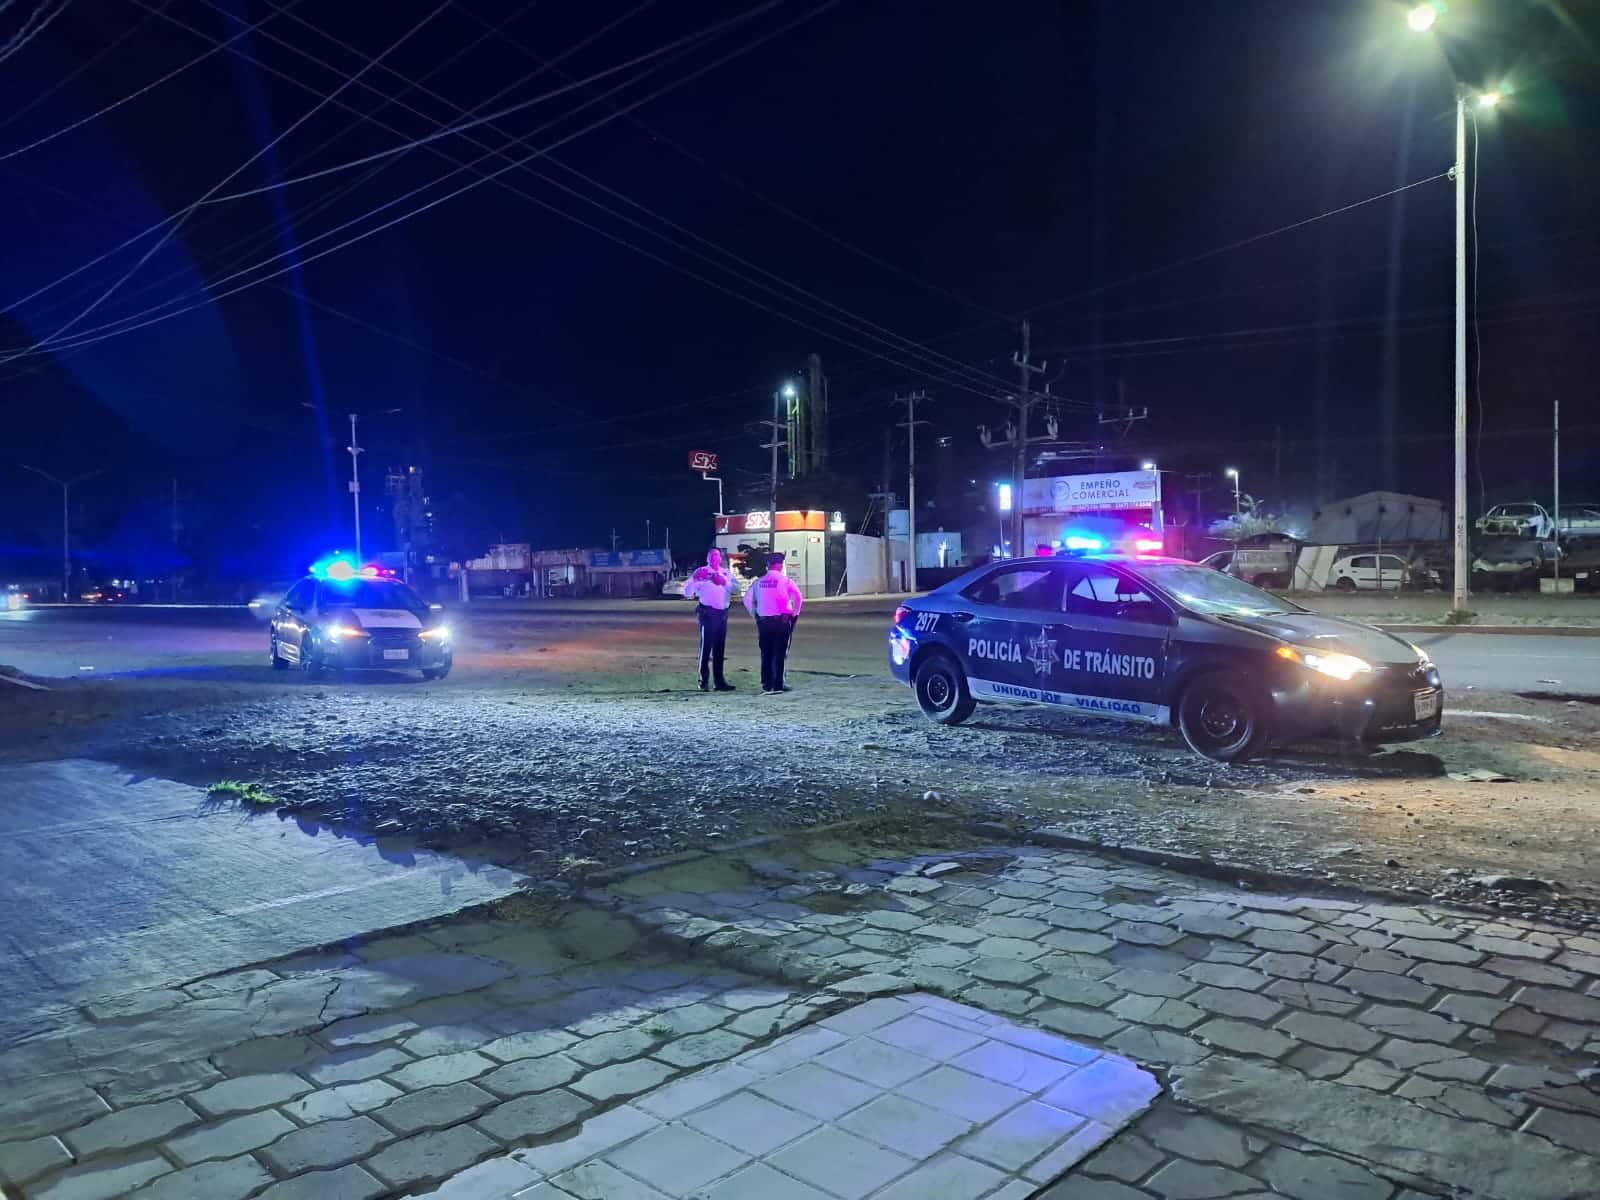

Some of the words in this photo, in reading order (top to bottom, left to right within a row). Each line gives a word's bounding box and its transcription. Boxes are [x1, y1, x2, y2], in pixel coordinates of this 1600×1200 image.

[1072, 489, 1129, 500] COMERCIAL
[1081, 479, 1120, 489] EMPEÑO
[746, 513, 770, 528] SIX
[915, 612, 940, 633] 2977
[968, 638, 1022, 663] POLICÍA
[1064, 648, 1081, 670] DE
[1085, 648, 1155, 679] TRÁNSITO
[992, 683, 1037, 700] UNIDAD
[1076, 697, 1141, 714] VIALIDAD
